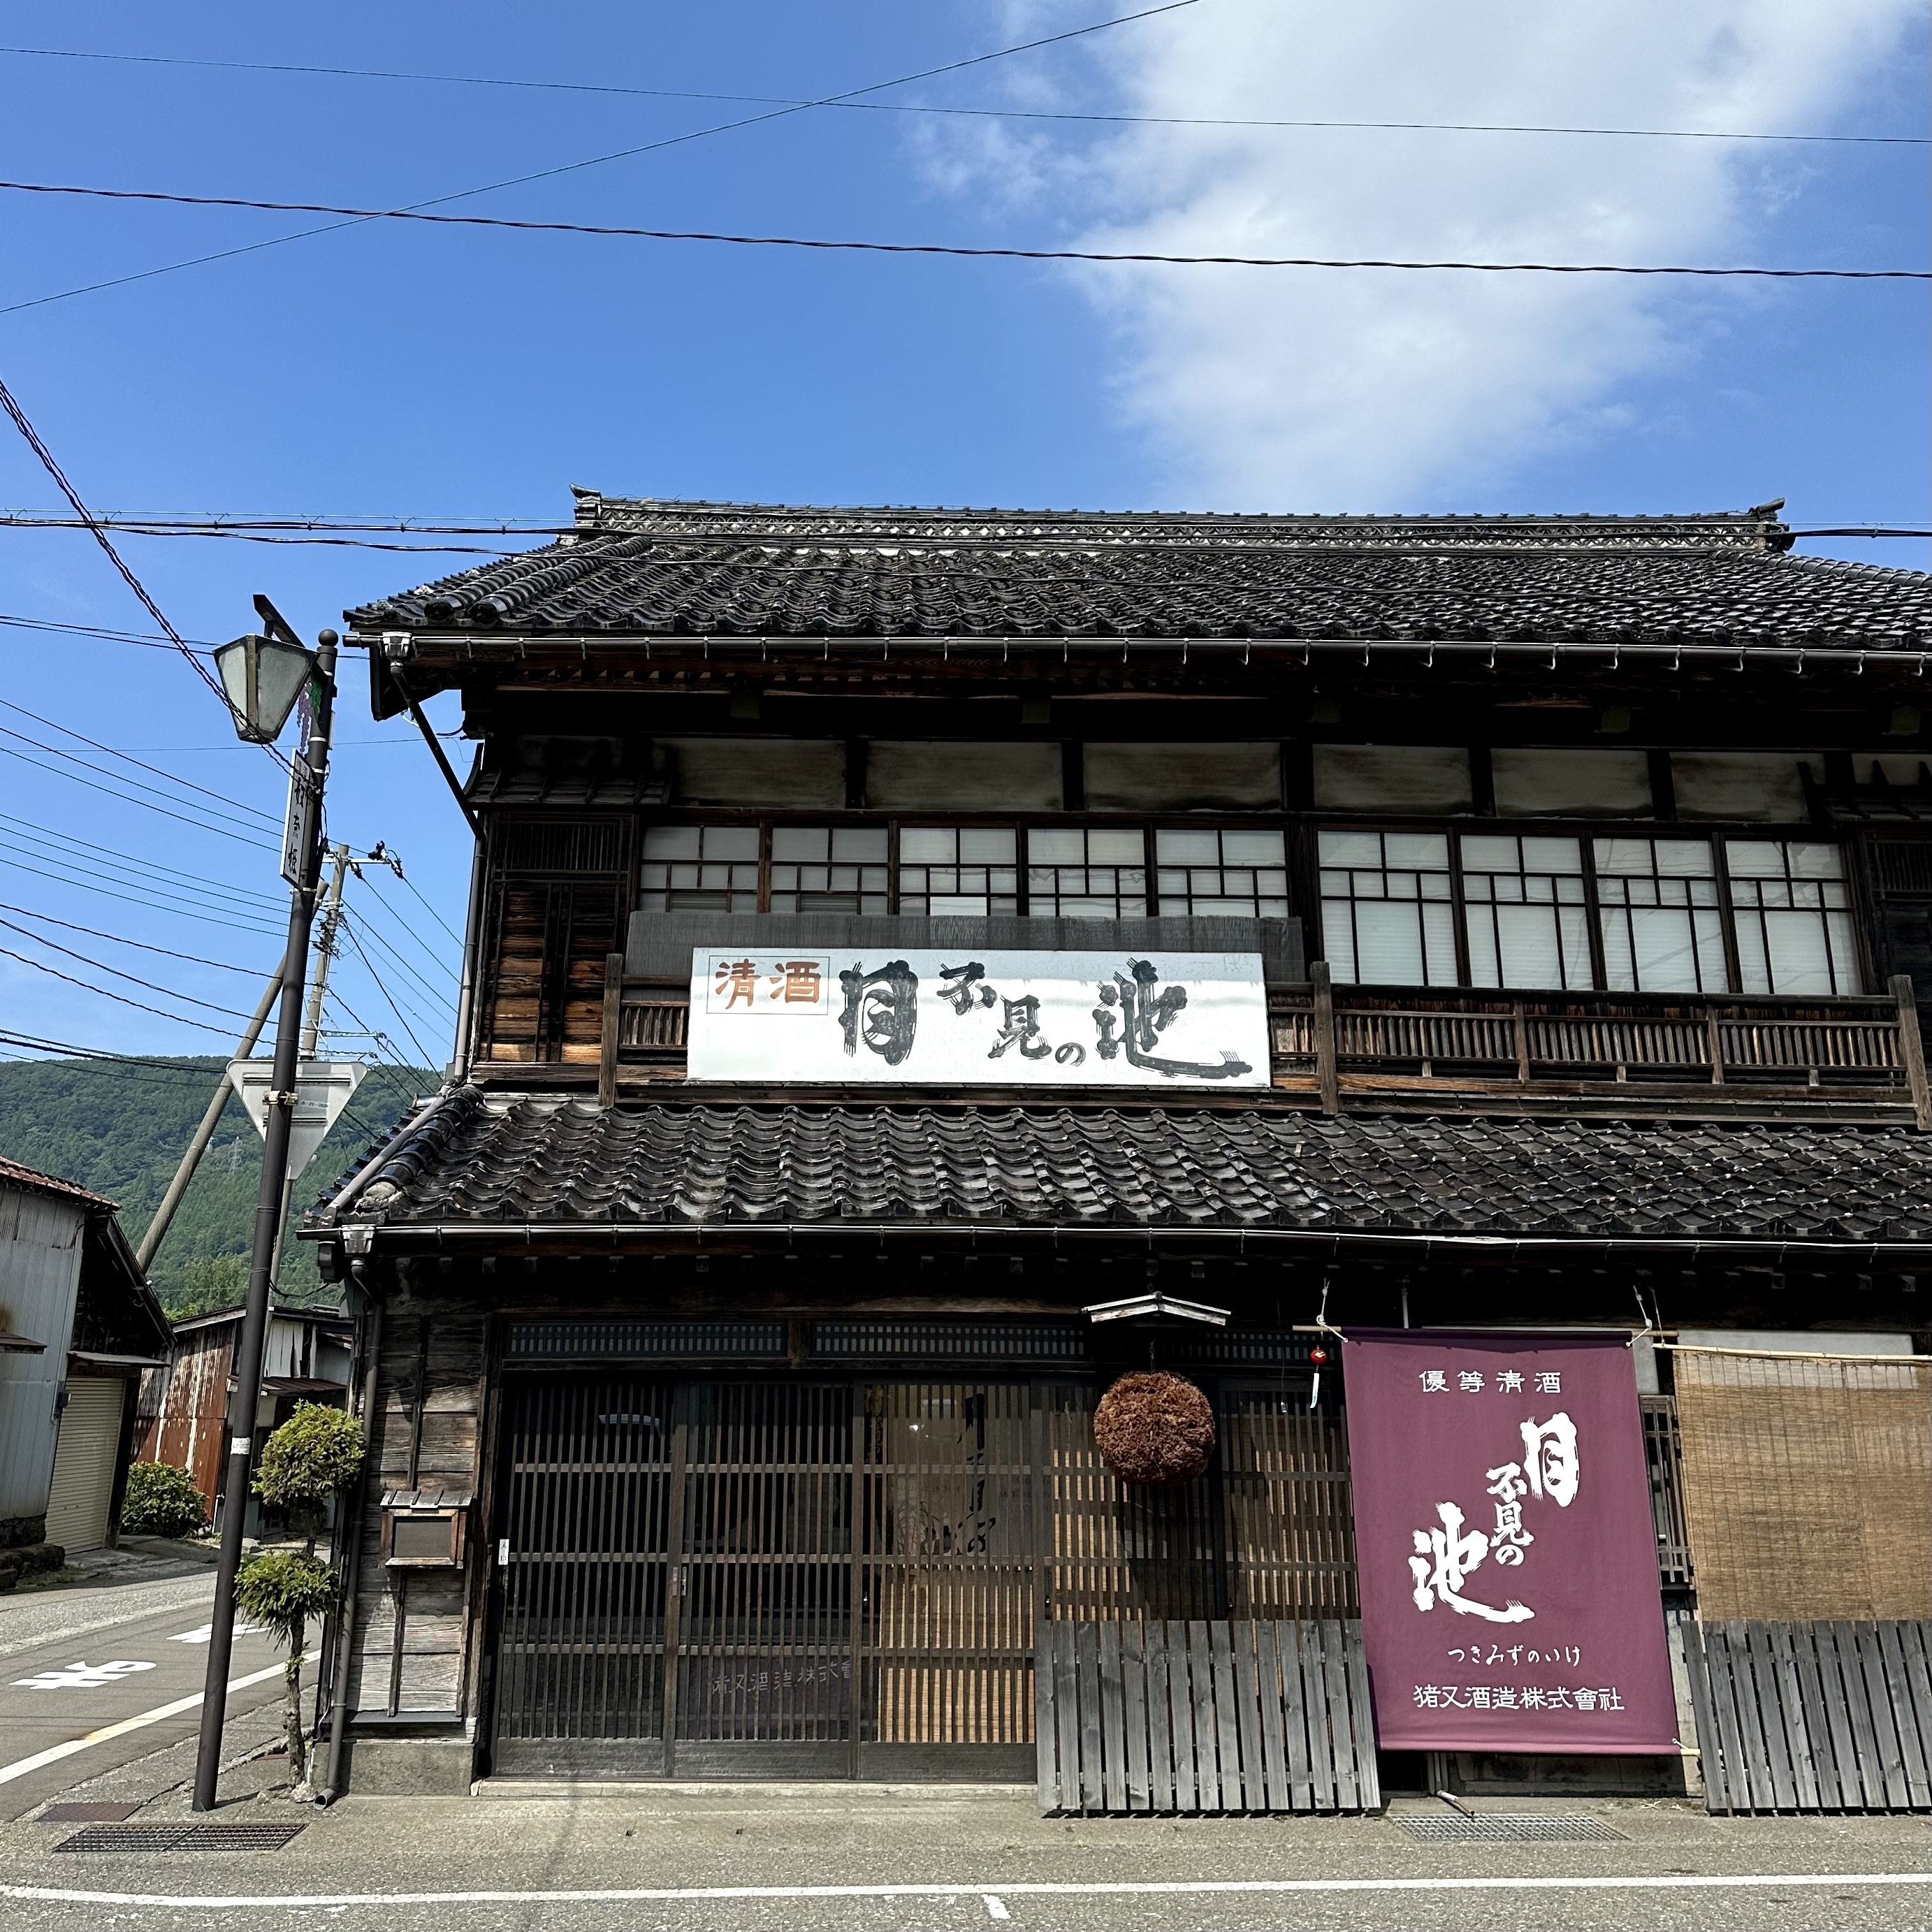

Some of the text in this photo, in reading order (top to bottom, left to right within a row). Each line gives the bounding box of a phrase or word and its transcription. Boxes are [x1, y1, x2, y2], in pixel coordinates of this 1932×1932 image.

[716, 960, 820, 1008] 清酒
[838, 958, 1253, 1079] 月不見の池
[1418, 1369, 1561, 1393] 優等清酒
[1448, 1644, 1581, 1667] つきみずのいけ
[1413, 1683, 1625, 1711] 猪又酒造株式會社
